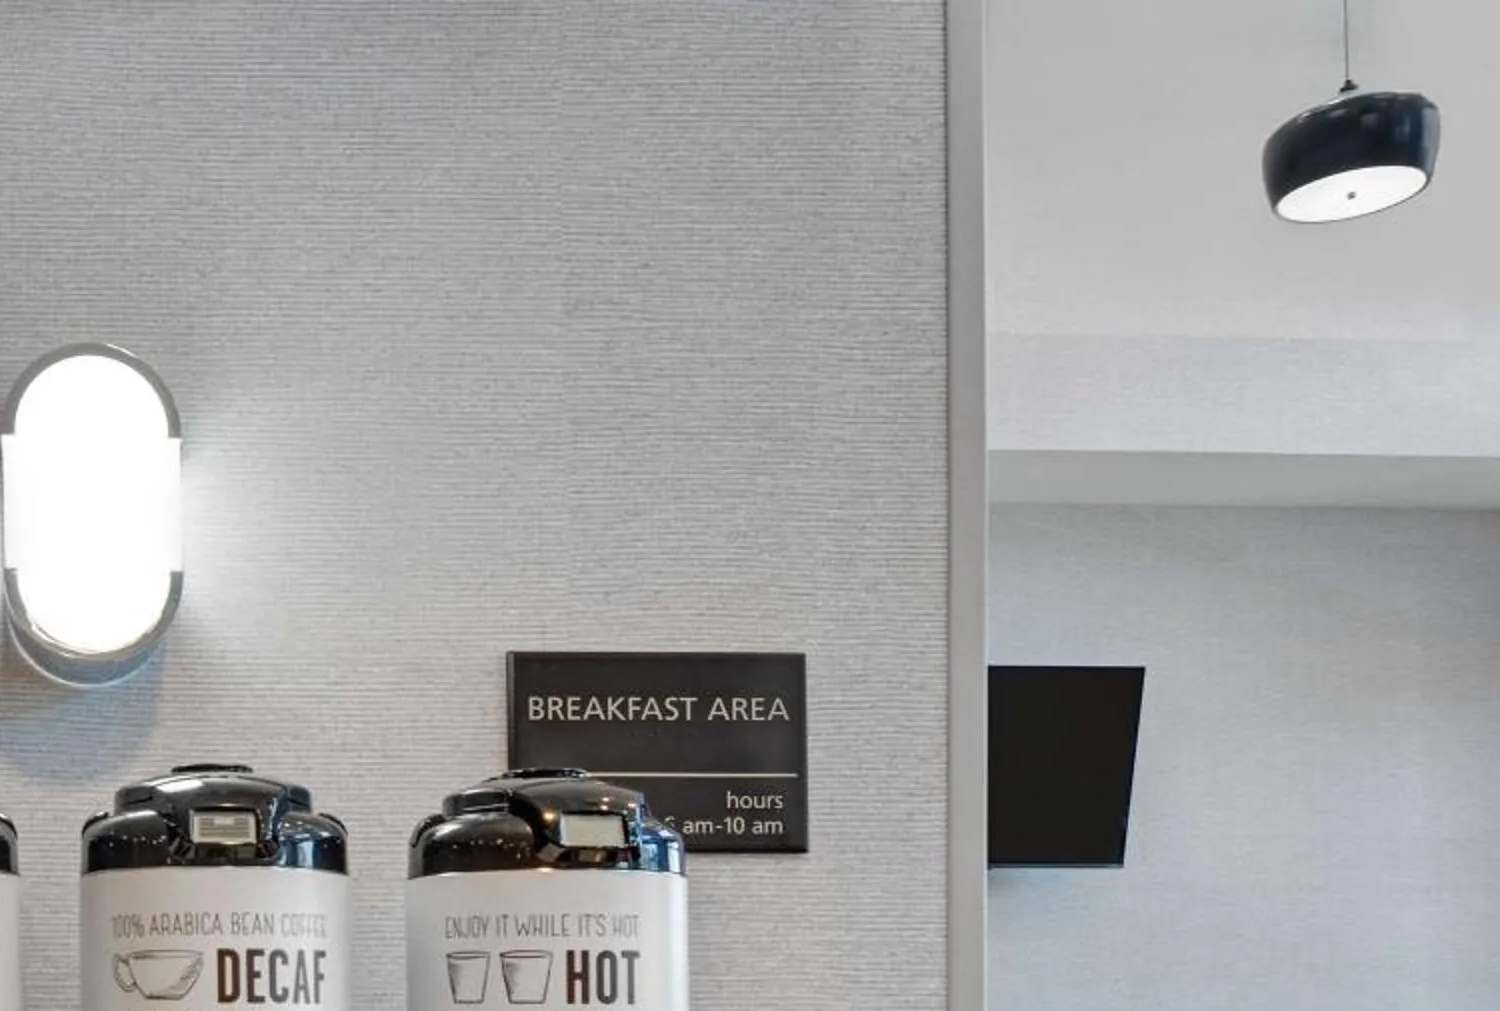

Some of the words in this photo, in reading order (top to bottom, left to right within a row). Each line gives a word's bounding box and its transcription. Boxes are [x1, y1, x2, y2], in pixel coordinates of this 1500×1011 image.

[527, 696, 698, 721] BREAKFAST
[707, 697, 790, 721] AREA
[726, 790, 783, 809] hours
[682, 816, 745, 834] am-10
[752, 820, 783, 834] am
[111, 914, 144, 938] 100%
[149, 913, 223, 936] ARABICA
[231, 912, 275, 936] BEAN
[281, 914, 328, 938] COFFEE
[445, 915, 490, 939] ENJOY
[495, 914, 508, 938] IT
[514, 913, 570, 937] WHILE
[578, 914, 606, 938] IT'S
[613, 915, 640, 938] HOT
[217, 948, 327, 1004] DECAF
[566, 949, 641, 1005] HOT
